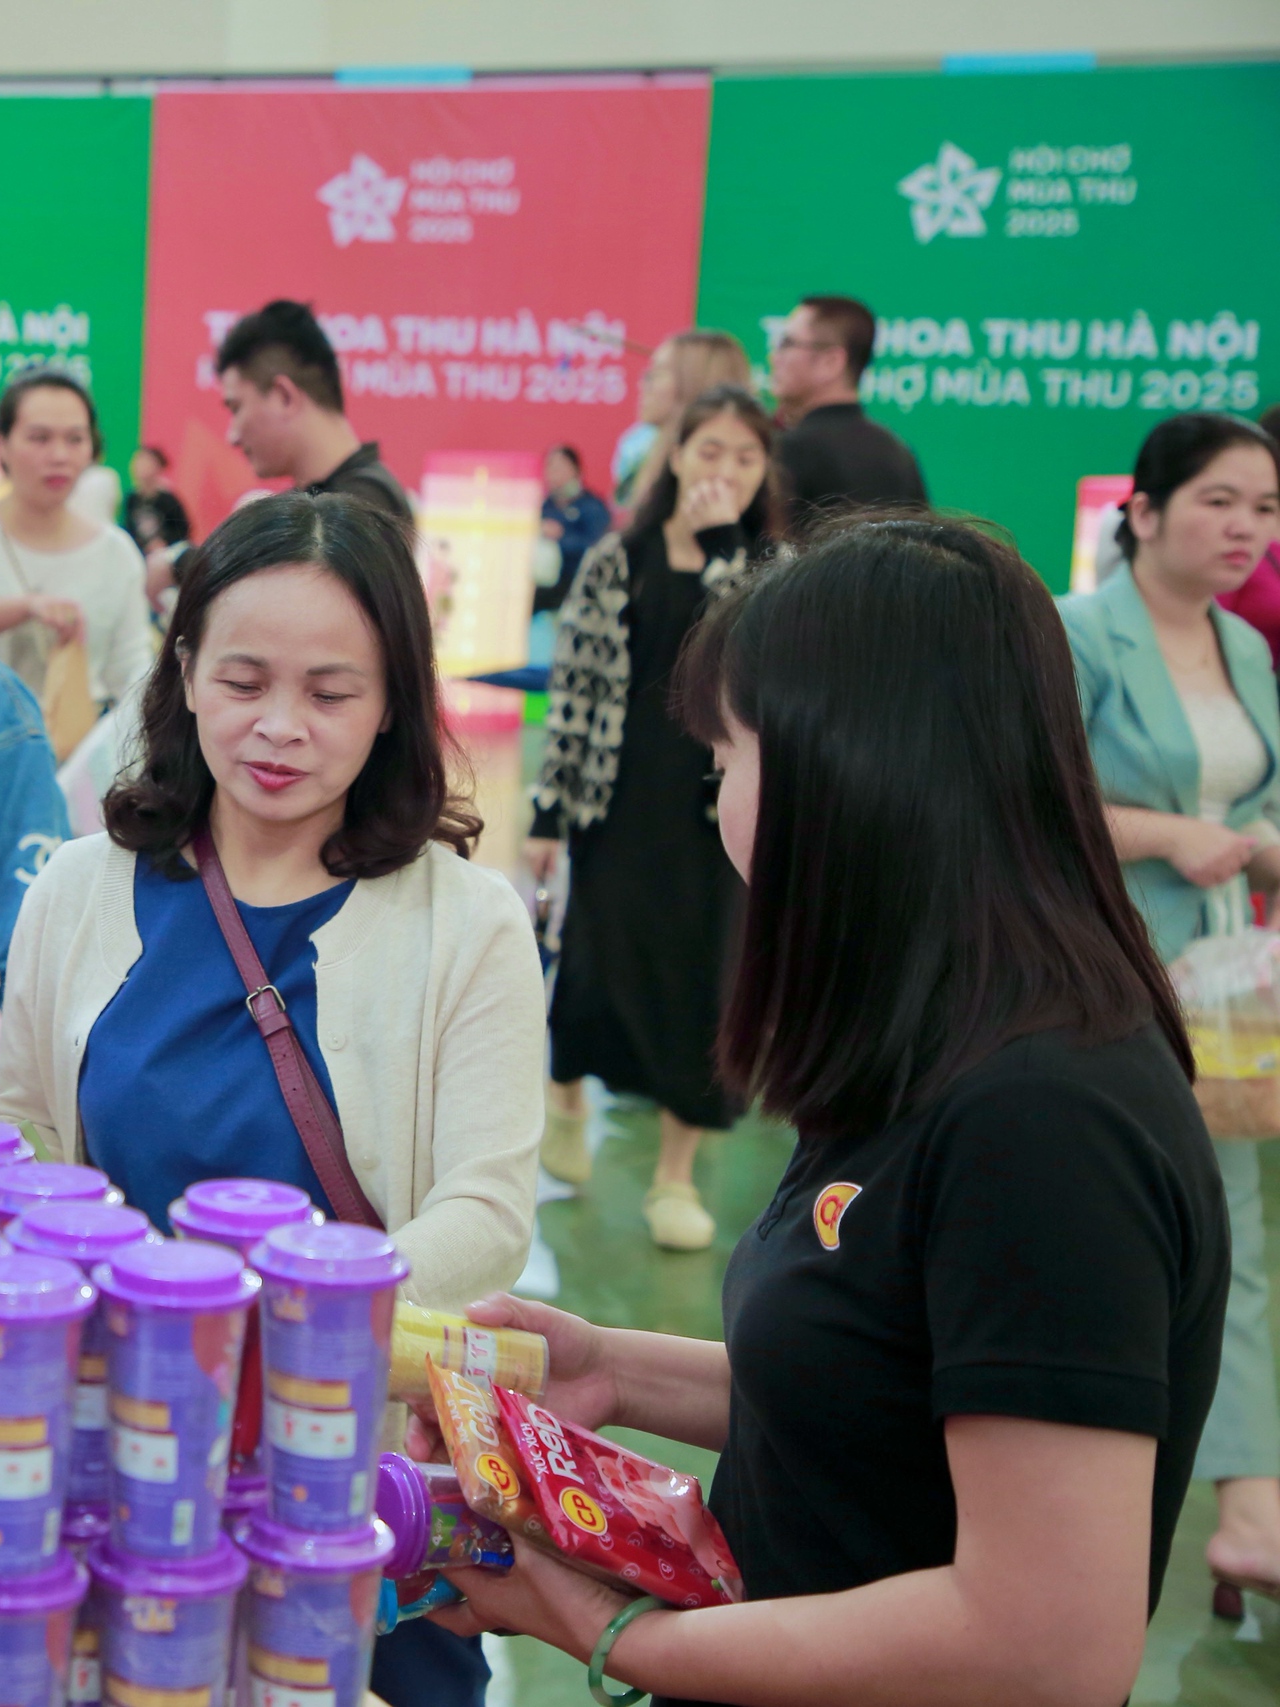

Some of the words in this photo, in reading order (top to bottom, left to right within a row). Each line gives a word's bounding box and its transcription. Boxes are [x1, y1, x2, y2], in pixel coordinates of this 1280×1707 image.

[22, 304, 89, 352] NỘI
[391, 314, 476, 353] THU
[480, 308, 541, 356] HÀ
[873, 316, 973, 358] HOA
[982, 317, 1082, 360] THU
[1086, 309, 1158, 360] HÀ
[1167, 310, 1260, 369] NỘI
[352, 352, 436, 397] MÙA
[442, 361, 519, 399] THU
[525, 363, 626, 403] 2025
[858, 362, 927, 413] HỢ
[931, 358, 1030, 407] MÙA
[1040, 367, 1132, 410] THU
[1138, 370, 1260, 411] 2025
[520, 1422, 540, 1449] XÍCH
[488, 1459, 511, 1490] CP
[530, 1448, 549, 1475] XÚC
[572, 1494, 598, 1527] CP
